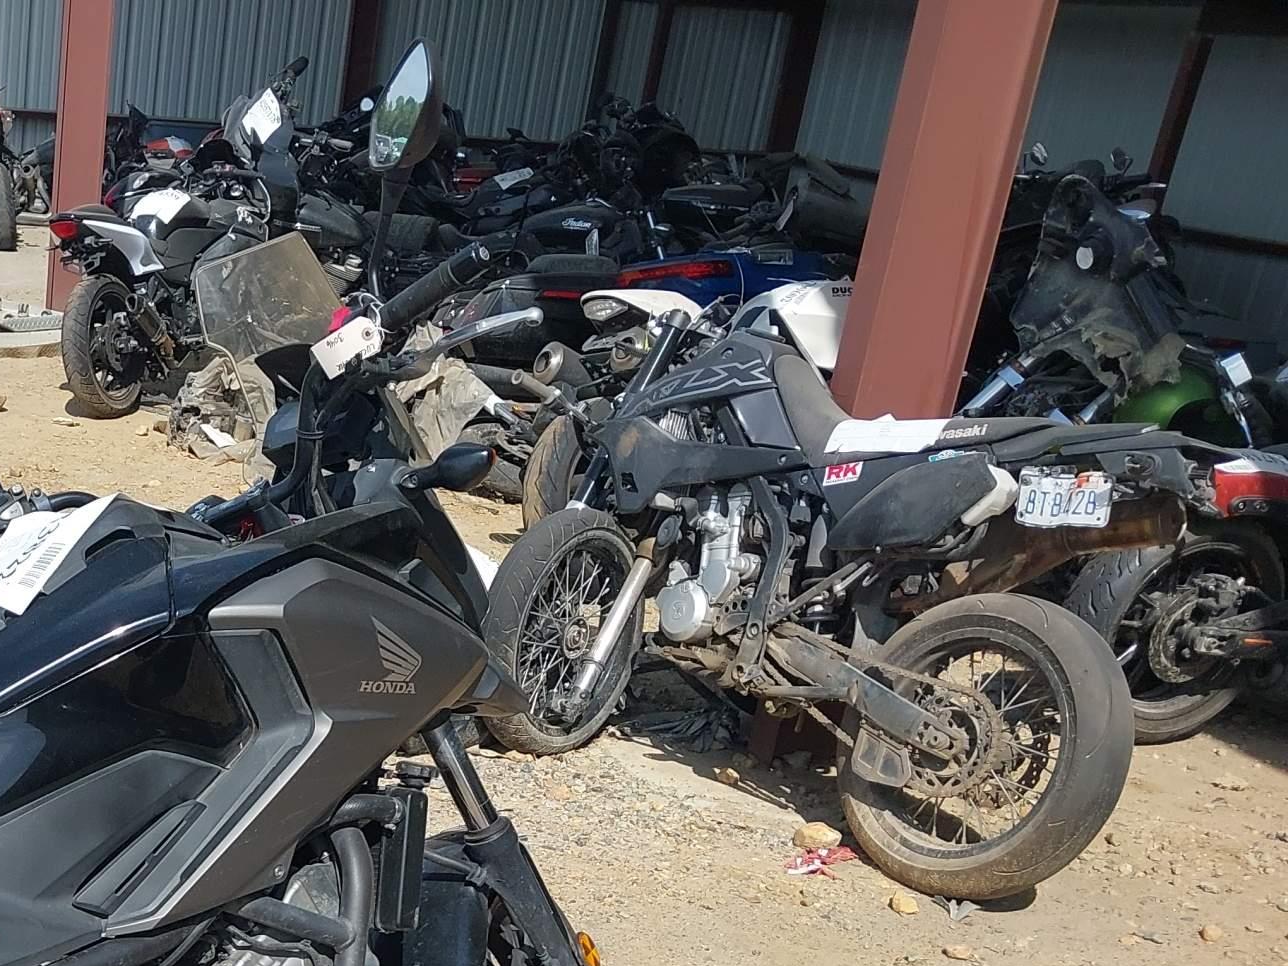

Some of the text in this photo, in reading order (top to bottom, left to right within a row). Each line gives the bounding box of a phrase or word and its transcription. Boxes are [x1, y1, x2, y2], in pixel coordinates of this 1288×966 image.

[831, 286, 854, 294] DUC
[826, 463, 859, 480] RK
[359, 680, 416, 694] HONDA
